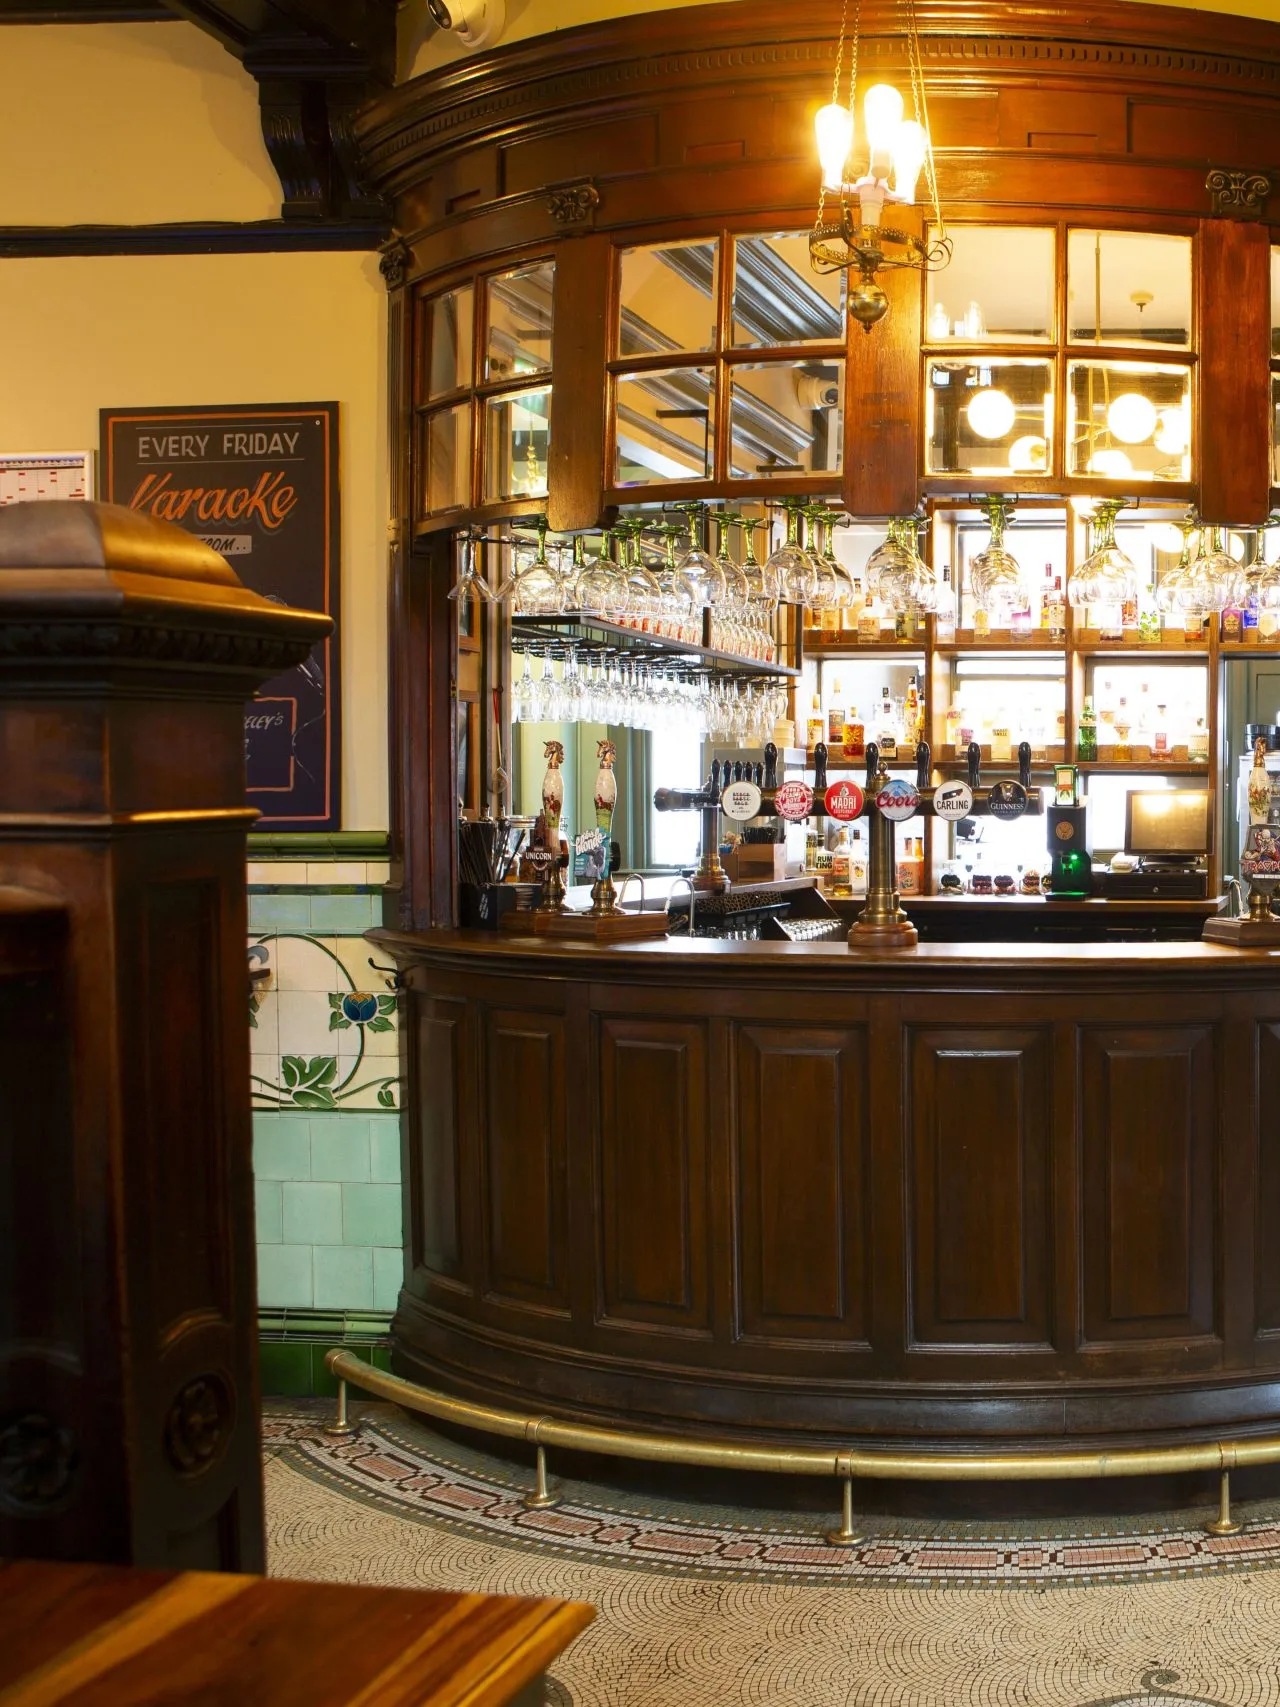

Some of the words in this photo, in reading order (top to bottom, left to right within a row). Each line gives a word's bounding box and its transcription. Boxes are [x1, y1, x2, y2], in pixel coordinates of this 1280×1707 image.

[138, 434, 209, 459] EVERY
[222, 431, 300, 457] FRIDAY
[876, 791, 919, 808] Coors
[936, 800, 969, 810] CARLING
[525, 851, 552, 861] UNICORN
[817, 855, 833, 863] RUM
